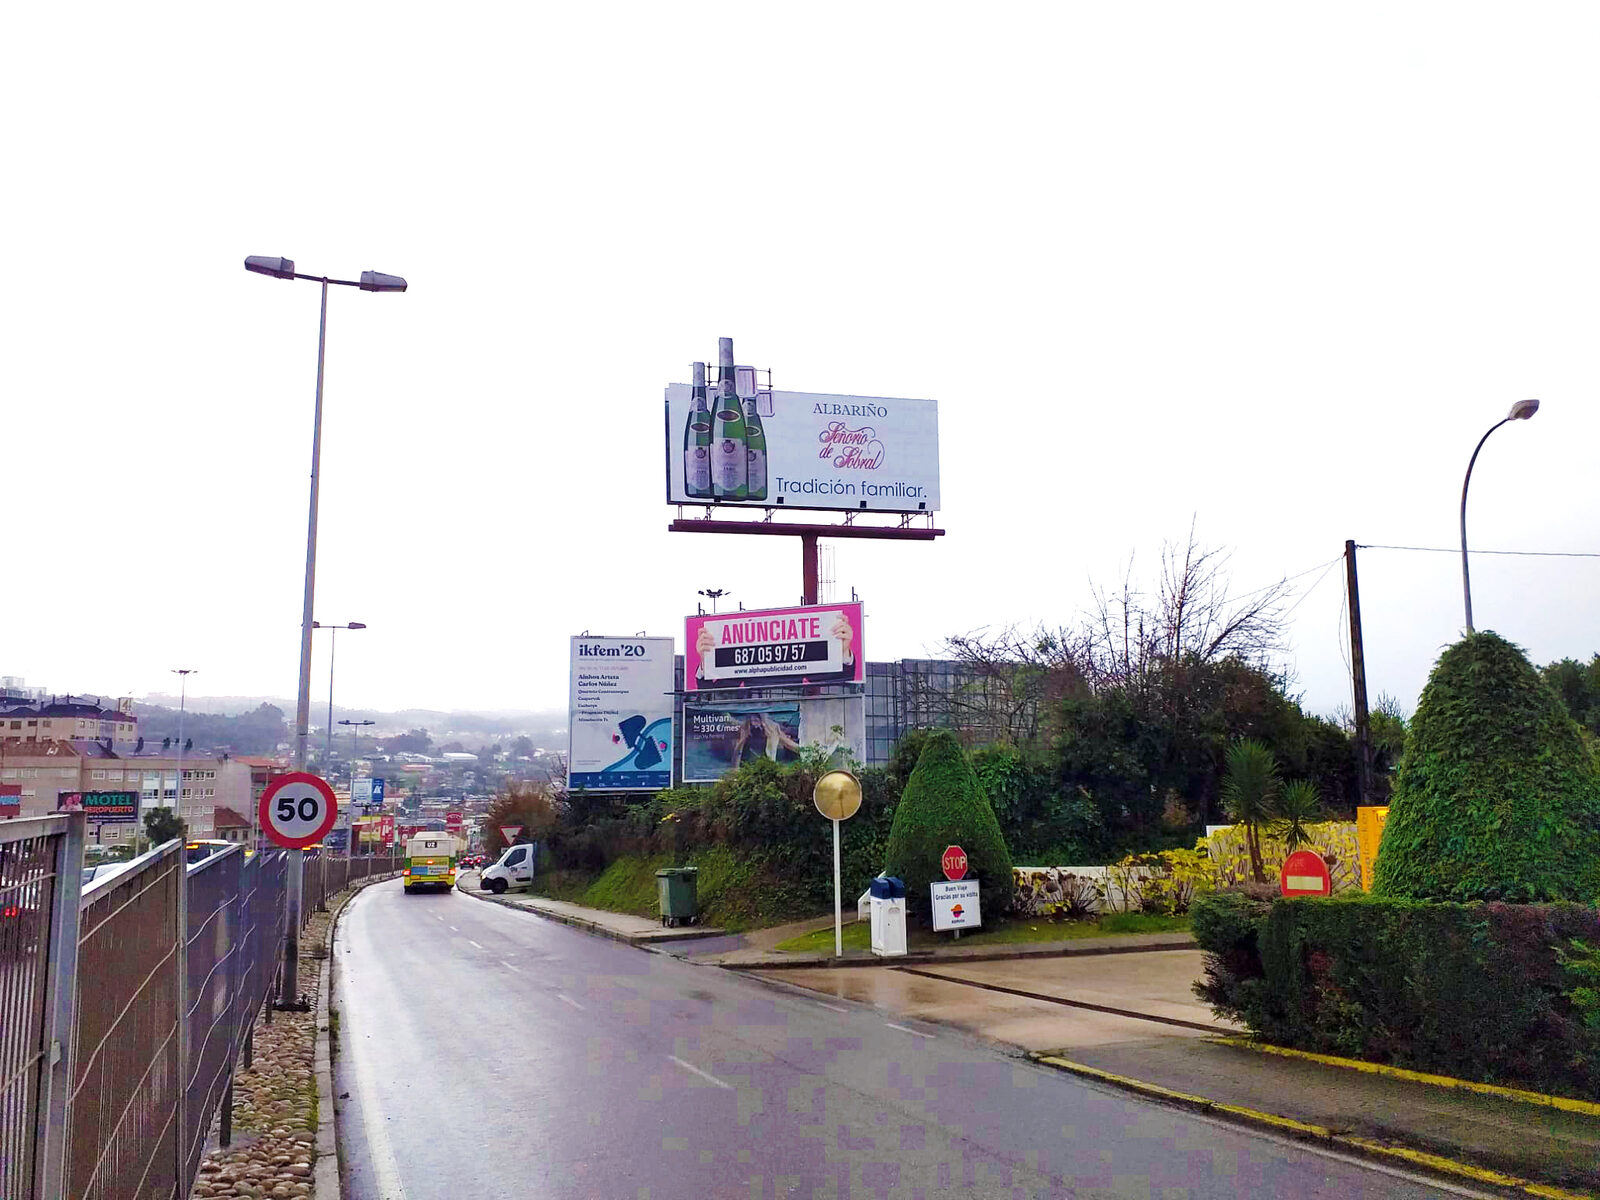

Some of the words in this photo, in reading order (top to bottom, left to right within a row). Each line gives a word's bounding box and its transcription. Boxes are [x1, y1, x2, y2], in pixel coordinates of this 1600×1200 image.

[813, 402, 888, 418] ALBARIÑO
[819, 442, 834, 459] de
[833, 439, 885, 470] Sobral
[775, 477, 856, 496] Tradición
[861, 480, 928, 499] familiar.
[721, 617, 821, 644] ANÚNCIATE
[578, 644, 646, 657] ikfem'20
[734, 647, 756, 665] 687
[757, 646, 773, 663] 05
[774, 644, 789, 662] 97
[791, 643, 806, 661] 57
[734, 664, 807, 675] www.alphapublicidad.com
[693, 713, 730, 724] Multivan
[700, 724, 715, 733] 330
[85, 795, 133, 806] MOTEL
[276, 797, 319, 822] 50
[945, 856, 966, 870] STOP
